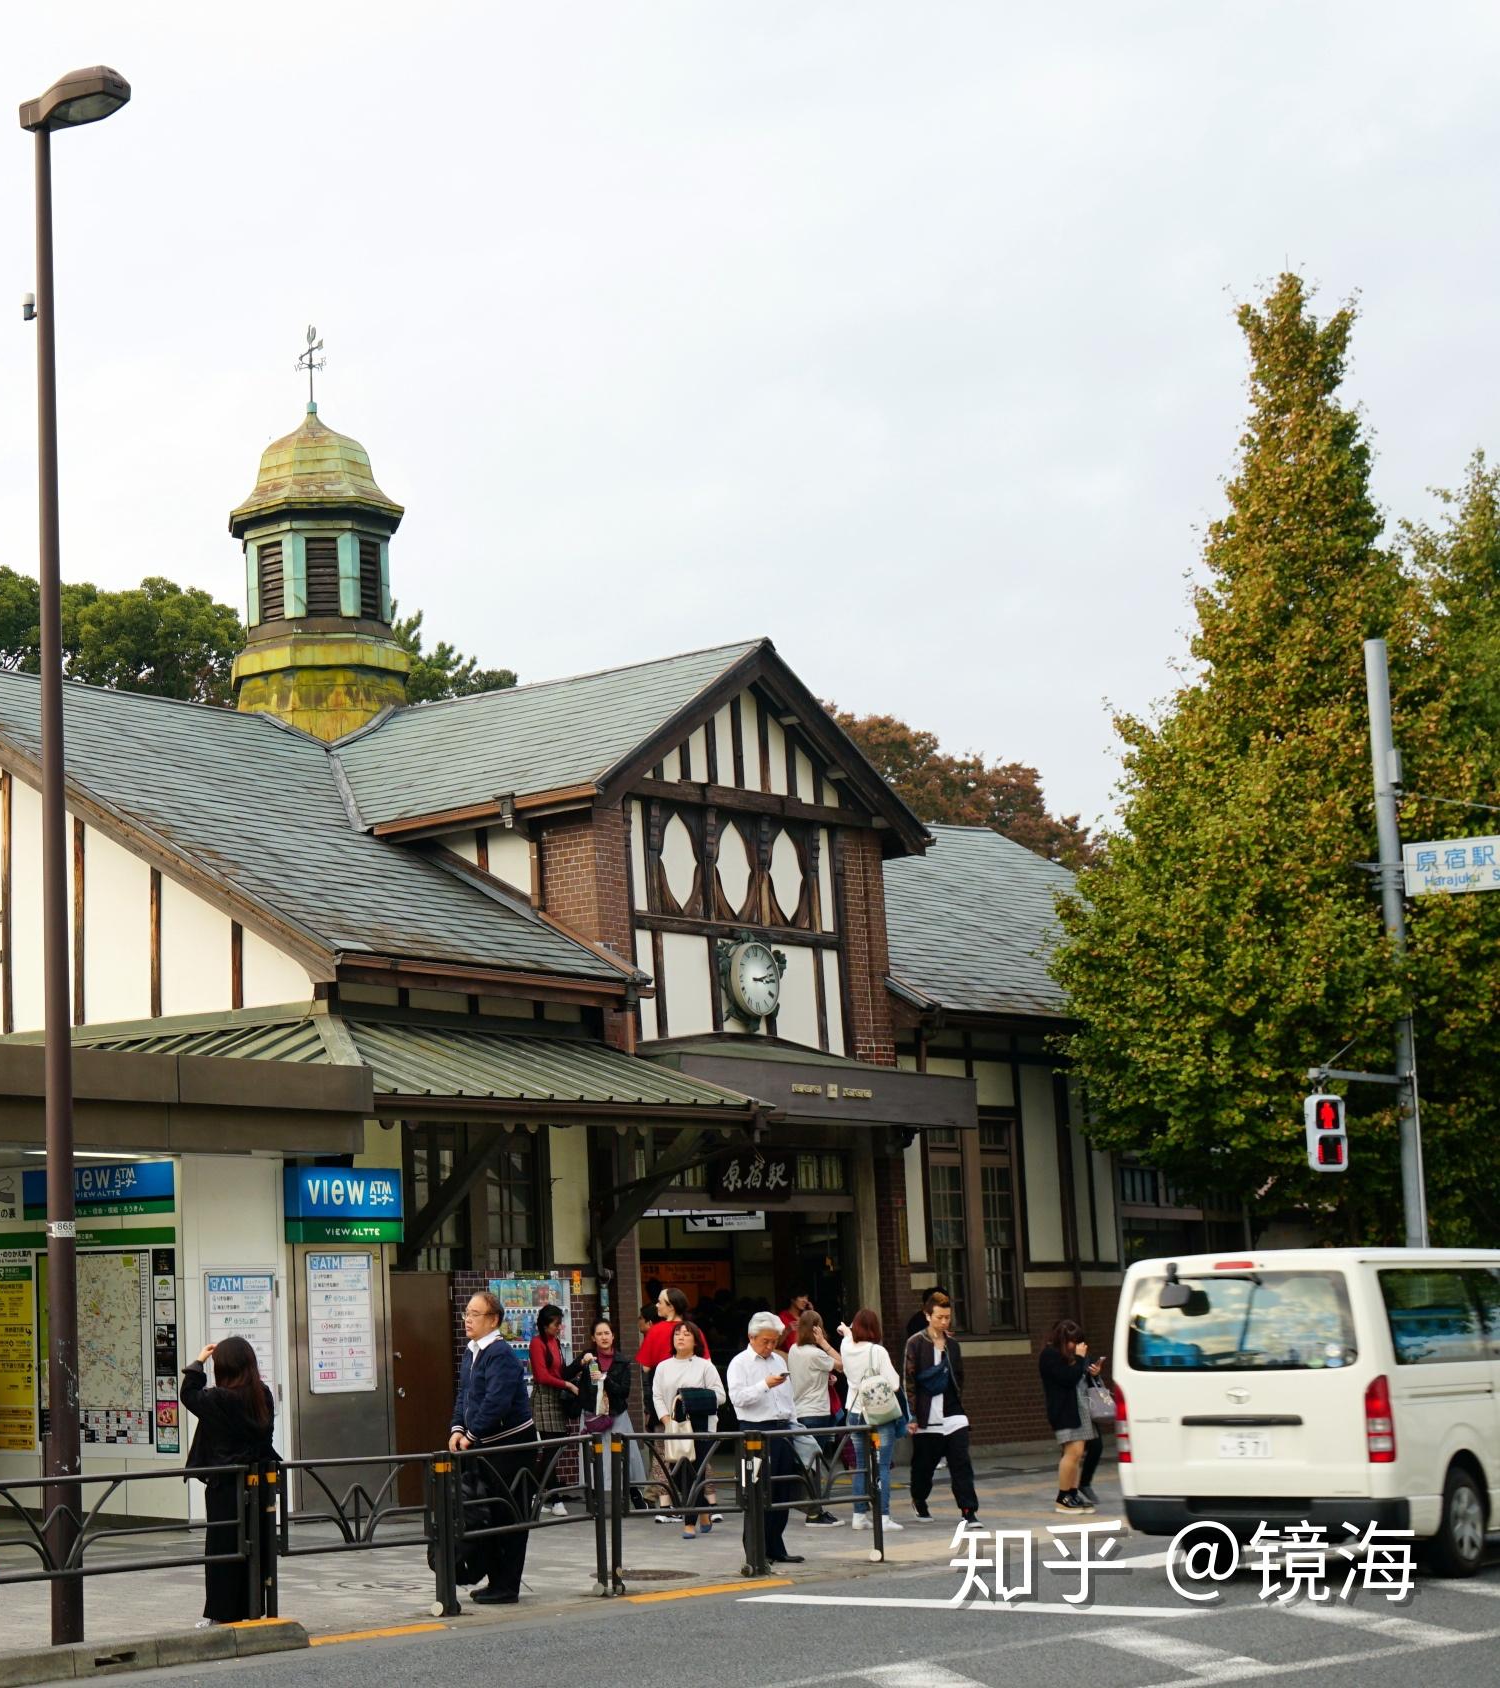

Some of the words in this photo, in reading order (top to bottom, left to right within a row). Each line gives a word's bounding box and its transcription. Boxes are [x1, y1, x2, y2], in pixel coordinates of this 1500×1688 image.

[1415, 844, 1496, 872] 原宿駅
[1425, 870, 1480, 887] Harajuku
[115, 1167, 135, 1180] ATM
[722, 1159, 789, 1193] 原宿駅
[115, 1180, 137, 1188] コーナー
[369, 1180, 392, 1195] ATM
[369, 1194, 394, 1205] コーナー
[325, 1227, 350, 1236] VIEW
[351, 1227, 381, 1236] ALTTE
[320, 1256, 341, 1269] ATM
[219, 1277, 241, 1291] ATM
